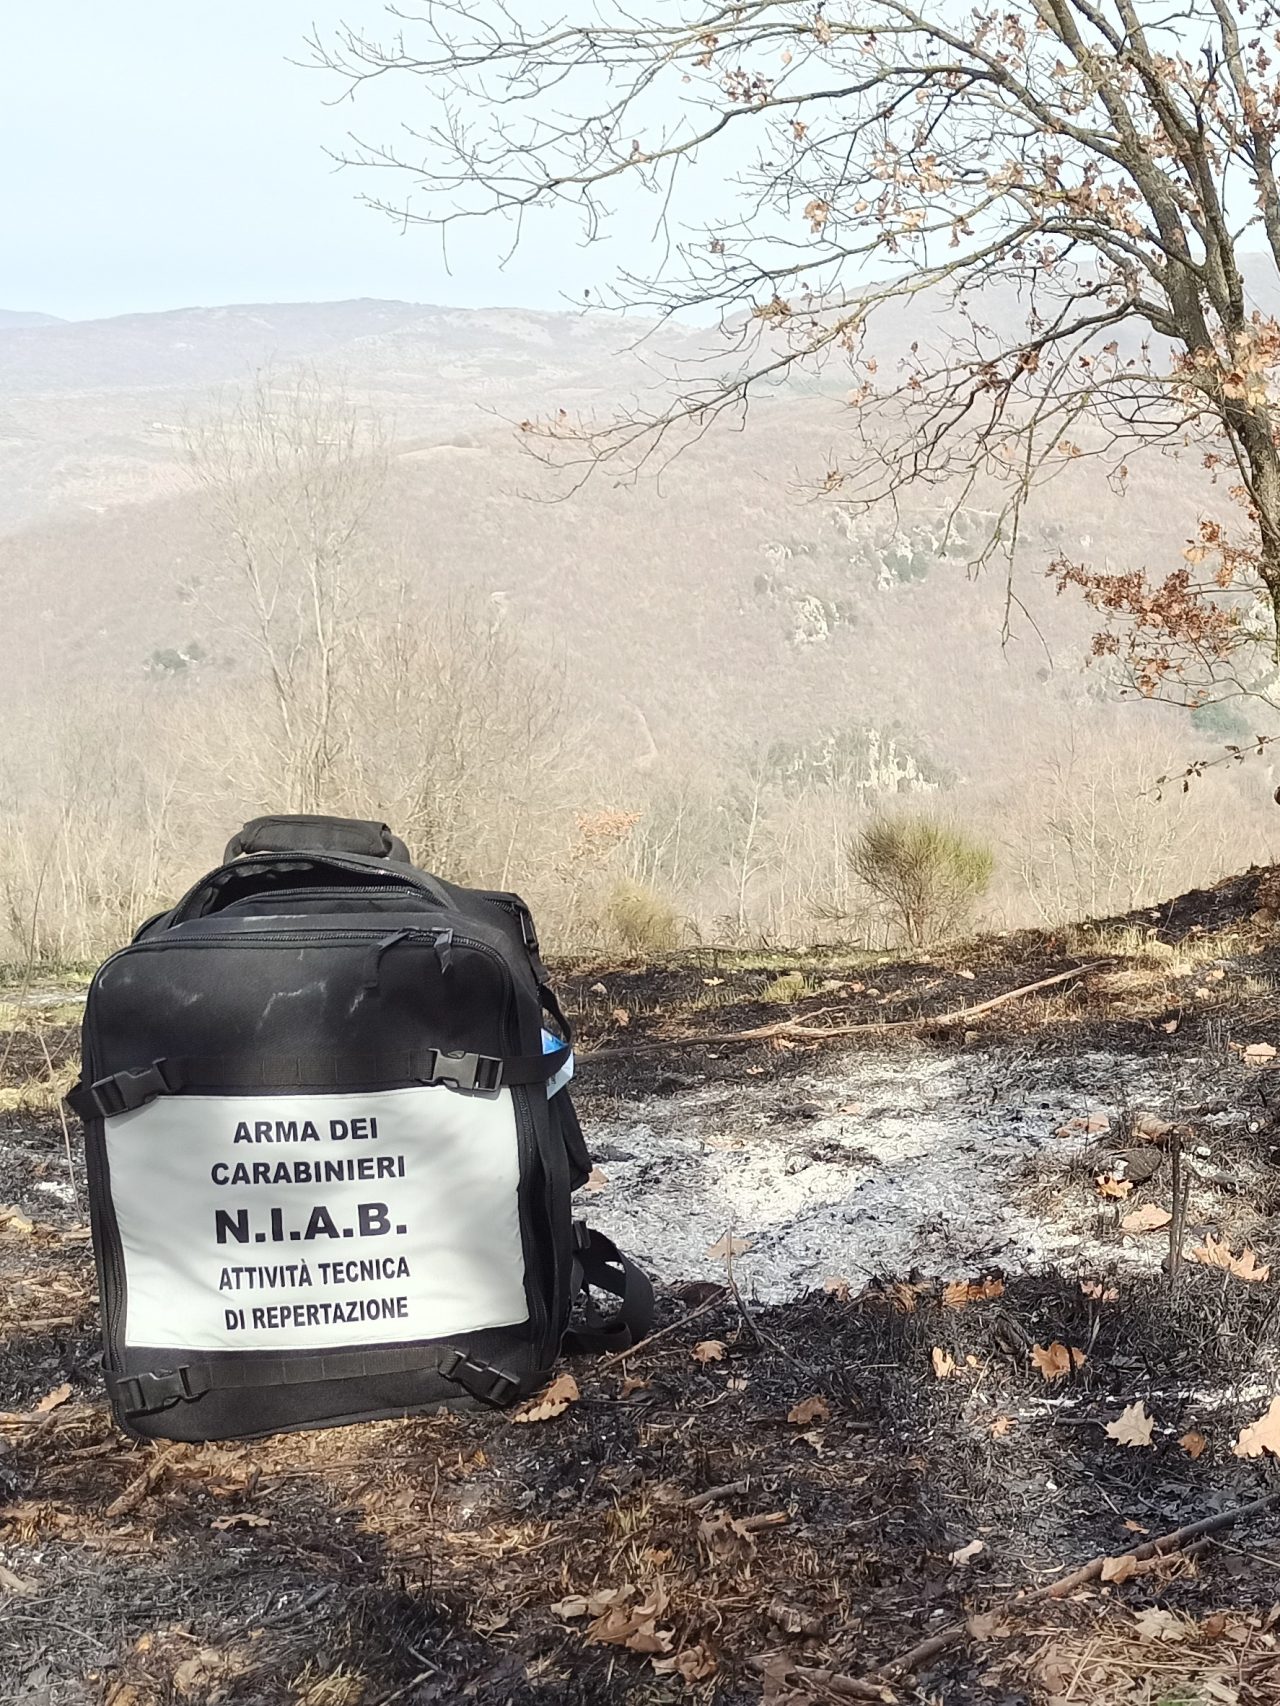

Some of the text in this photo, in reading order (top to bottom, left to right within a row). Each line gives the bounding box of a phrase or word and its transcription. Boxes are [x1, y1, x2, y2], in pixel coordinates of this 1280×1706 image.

[233, 1117, 378, 1144] ARMA DEI
[210, 1155, 405, 1186] CARABINIERI
[215, 1202, 407, 1244] N.I.A.B.
[219, 1256, 410, 1290] ATTIVITÀ TECNICA
[224, 1296, 407, 1330] DI REPERTAZIONE
